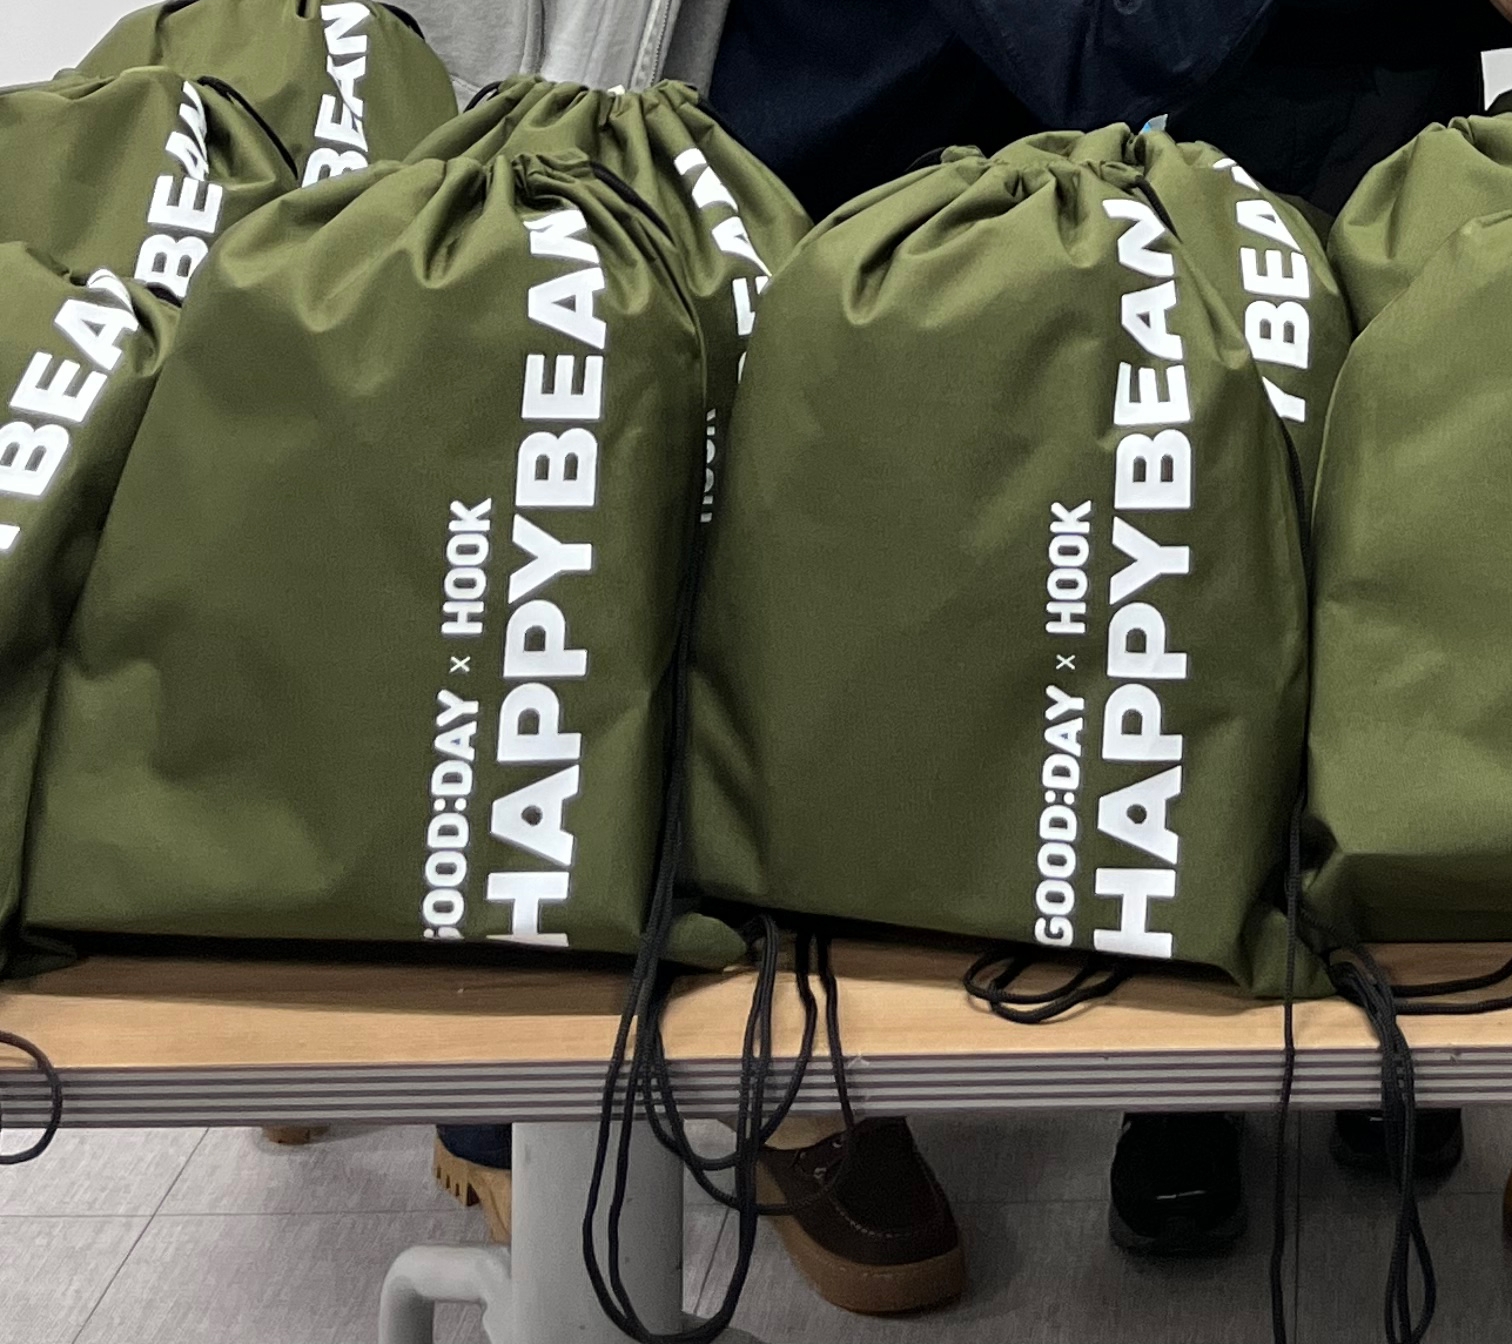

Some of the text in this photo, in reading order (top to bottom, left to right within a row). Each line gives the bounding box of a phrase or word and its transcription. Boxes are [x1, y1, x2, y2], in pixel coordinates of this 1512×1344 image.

[442, 497, 493, 636] HOOK
[486, 210, 609, 946] HAPPYBEAN
[1045, 499, 1092, 635] HOOK
[1092, 199, 1194, 957] HAPPYBEAN
[1034, 685, 1086, 947] GOOD:DAY
